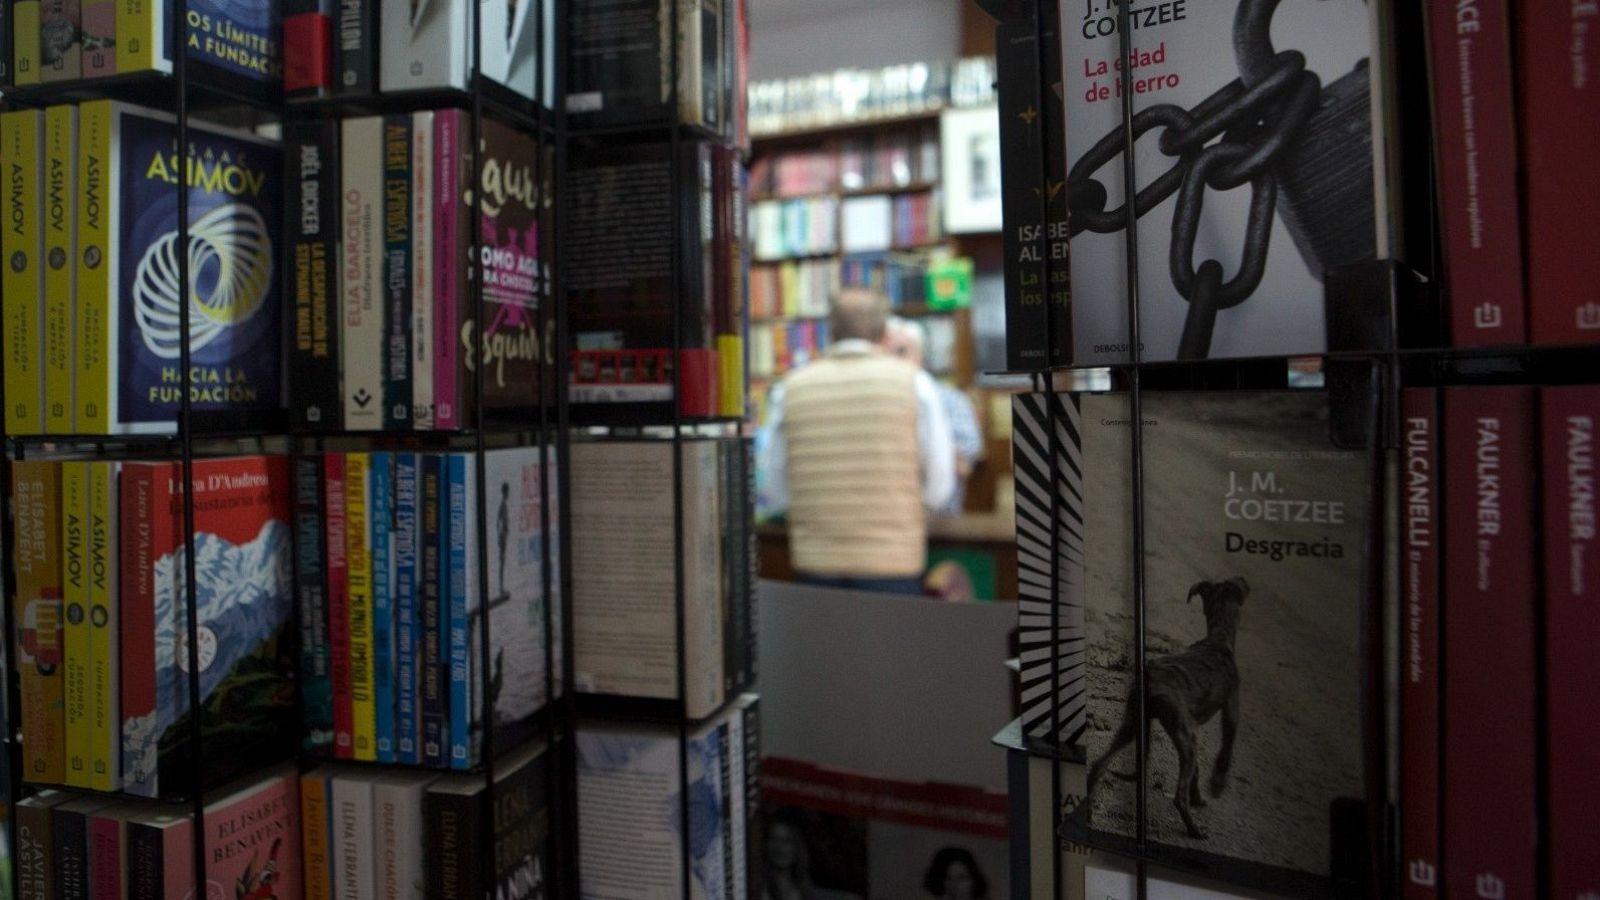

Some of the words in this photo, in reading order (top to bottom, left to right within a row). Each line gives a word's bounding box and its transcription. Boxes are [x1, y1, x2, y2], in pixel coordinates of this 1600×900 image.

[1084, 58, 1108, 78] La
[1113, 41, 1165, 71] edad
[1085, 81, 1109, 103] de
[51, 158, 64, 232] ASIMOV
[86, 154, 99, 230] ASIMOV
[145, 150, 267, 197] ASIMOV
[12, 163, 24, 236] ASIMOV
[300, 180, 320, 236] DICKER
[1018, 221, 1069, 243] ISABE
[396, 463, 416, 507] ALBERT
[1225, 470, 1243, 498] J.
[1251, 470, 1284, 493] M.
[1407, 416, 1430, 547] FULCANELLI
[1477, 416, 1501, 537] FAULKNER
[1567, 415, 1596, 541] FAULKNER
[17, 480, 32, 575] BENAVENT
[1224, 497, 1345, 525] COETZEE
[67, 514, 82, 588] ASIMOV
[92, 514, 106, 590] ASIMOV
[1225, 532, 1345, 562] Desgracia
[342, 801, 357, 839] ELENA
[383, 802, 395, 848] DULCE
